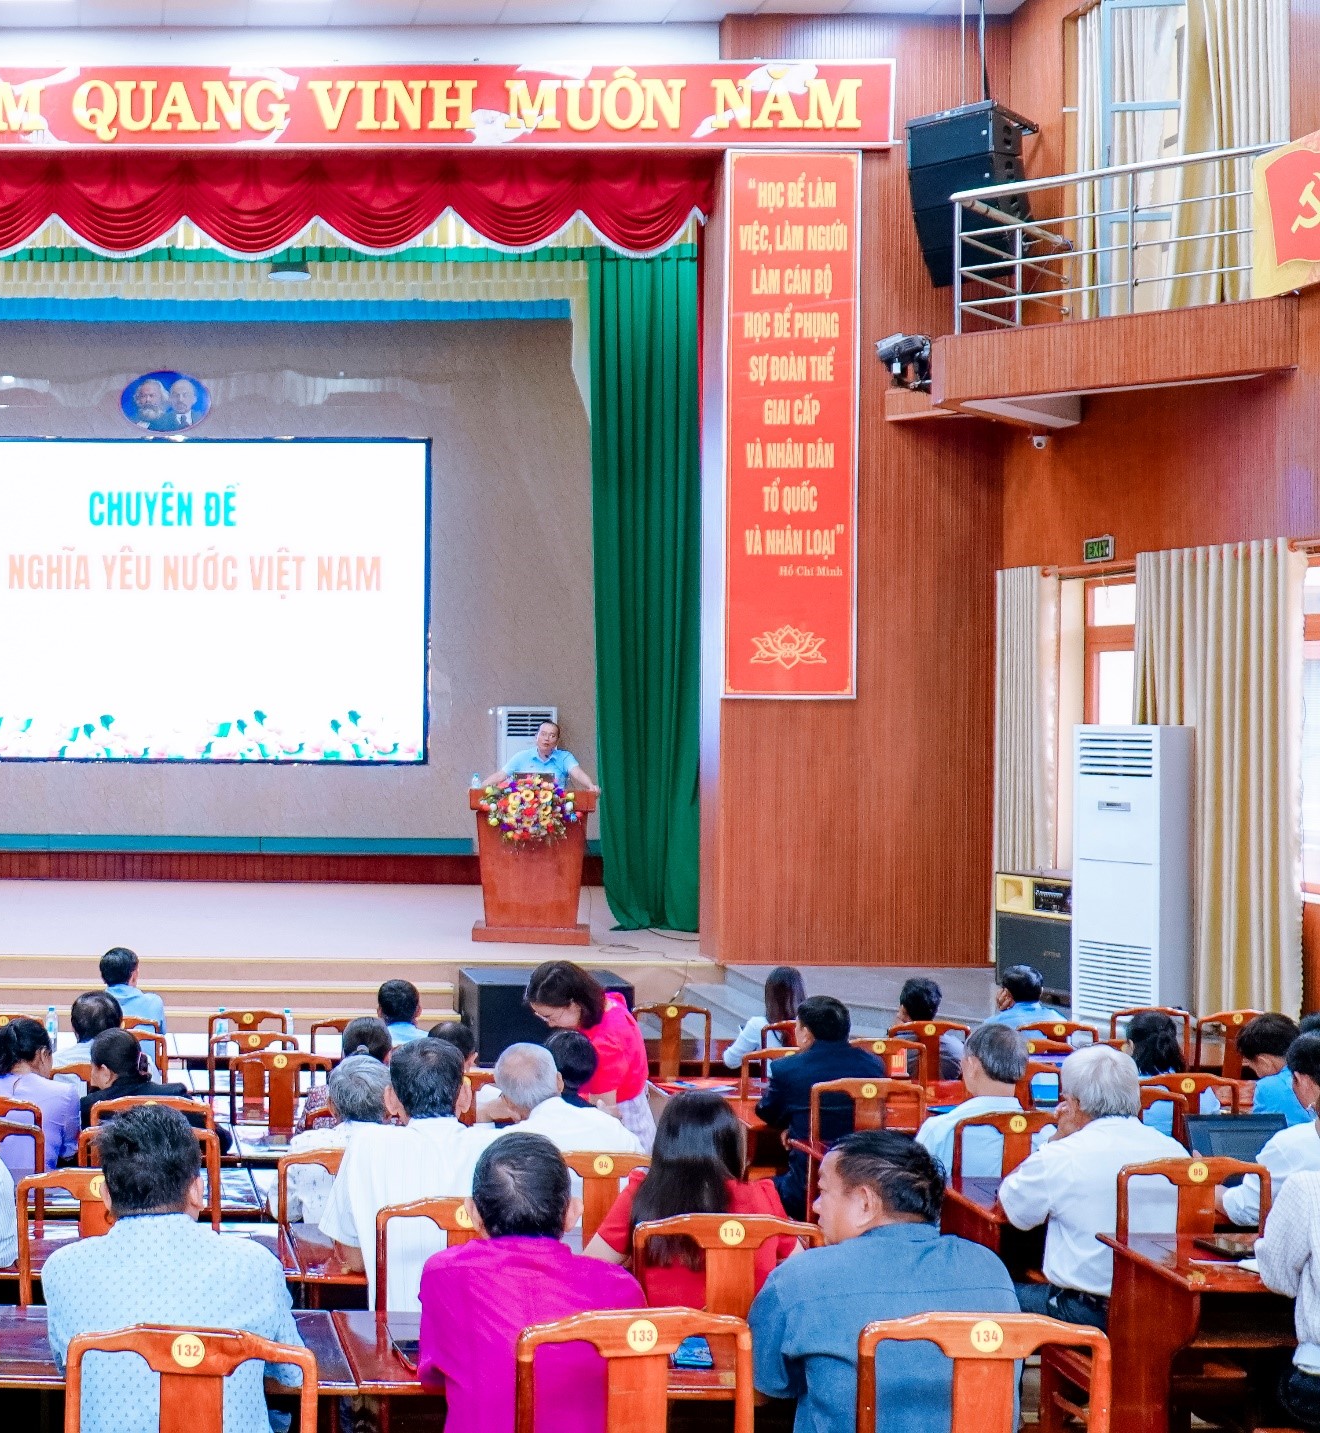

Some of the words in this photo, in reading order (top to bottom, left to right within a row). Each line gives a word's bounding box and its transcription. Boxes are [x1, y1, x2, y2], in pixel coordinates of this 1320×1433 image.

[72, 79, 290, 142] QUANG
[308, 80, 477, 131] VINH
[504, 65, 688, 131] MUÔN
[710, 67, 863, 129] NĂM
[787, 172, 806, 208] ĐỂ
[808, 176, 837, 208] LÀM
[739, 220, 773, 255] VIỆC,
[775, 219, 804, 251] LÀM
[807, 218, 848, 251] NGƯỜI
[751, 263, 781, 295] LÀM
[784, 263, 811, 295] CÁN
[814, 263, 833, 299] BỘ
[743, 311, 771, 343] HỌC
[773, 302, 793, 339] ĐỂ
[794, 311, 839, 343] PHỤNG
[749, 353, 769, 386] SỰ
[770, 350, 807, 382] ĐOÀN
[809, 346, 836, 382] THỂ
[763, 398, 790, 425] GIAI
[793, 393, 821, 425] CẤP
[745, 437, 763, 469] VÀ
[766, 438, 804, 469] NHÂN
[807, 437, 835, 469] DÂN
[88, 481, 193, 527] CHUYÊN
[203, 482, 240, 527] ĐỀ
[762, 477, 781, 512] TỔ
[783, 480, 818, 515] QUỐC
[744, 524, 763, 555] VÀ
[765, 524, 803, 555] NHÂN
[1087, 541, 1109, 558] EXIT
[8, 546, 91, 591] NGHĨA
[101, 545, 152, 591] YÊU
[163, 546, 239, 591] NƯỚC
[249, 547, 306, 600] VIỆT
[316, 556, 383, 591] NAM
[779, 565, 794, 577] Hồ
[796, 565, 814, 577] Chí
[816, 565, 843, 577] Minh
[598, 1161, 608, 1169] 94
[1193, 1167, 1203, 1175] 95
[723, 1228, 741, 1237] 114
[177, 1344, 201, 1357] 132
[632, 1330, 653, 1342] 133
[975, 1330, 999, 1342] 134
